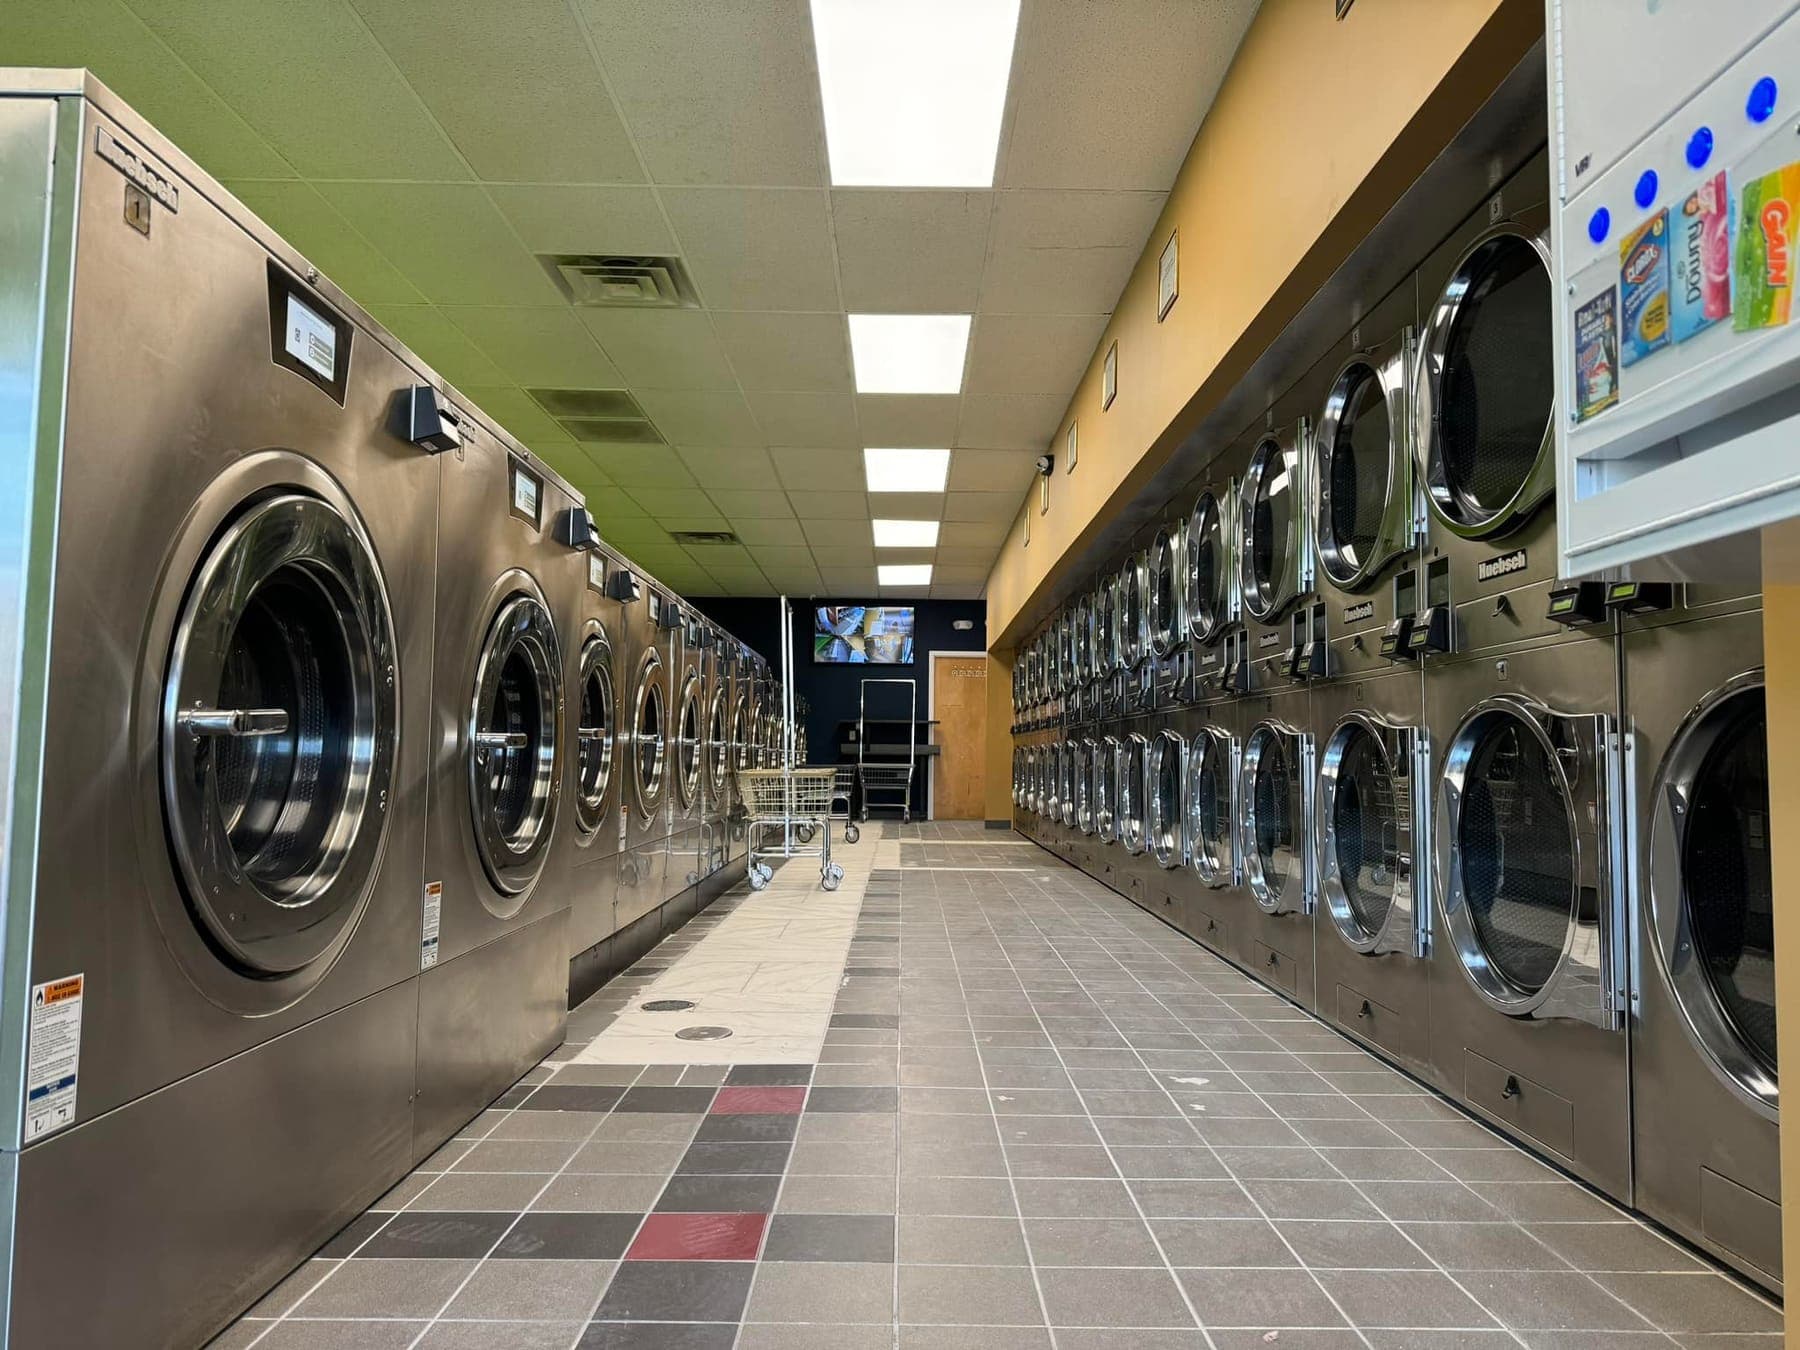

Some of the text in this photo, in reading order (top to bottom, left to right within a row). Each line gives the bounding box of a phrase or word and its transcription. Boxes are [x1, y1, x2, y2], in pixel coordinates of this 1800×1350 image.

[1687, 219, 1704, 305] Downy
[1760, 199, 1790, 287] GAIN
[1479, 551, 1526, 579] Huebsch
